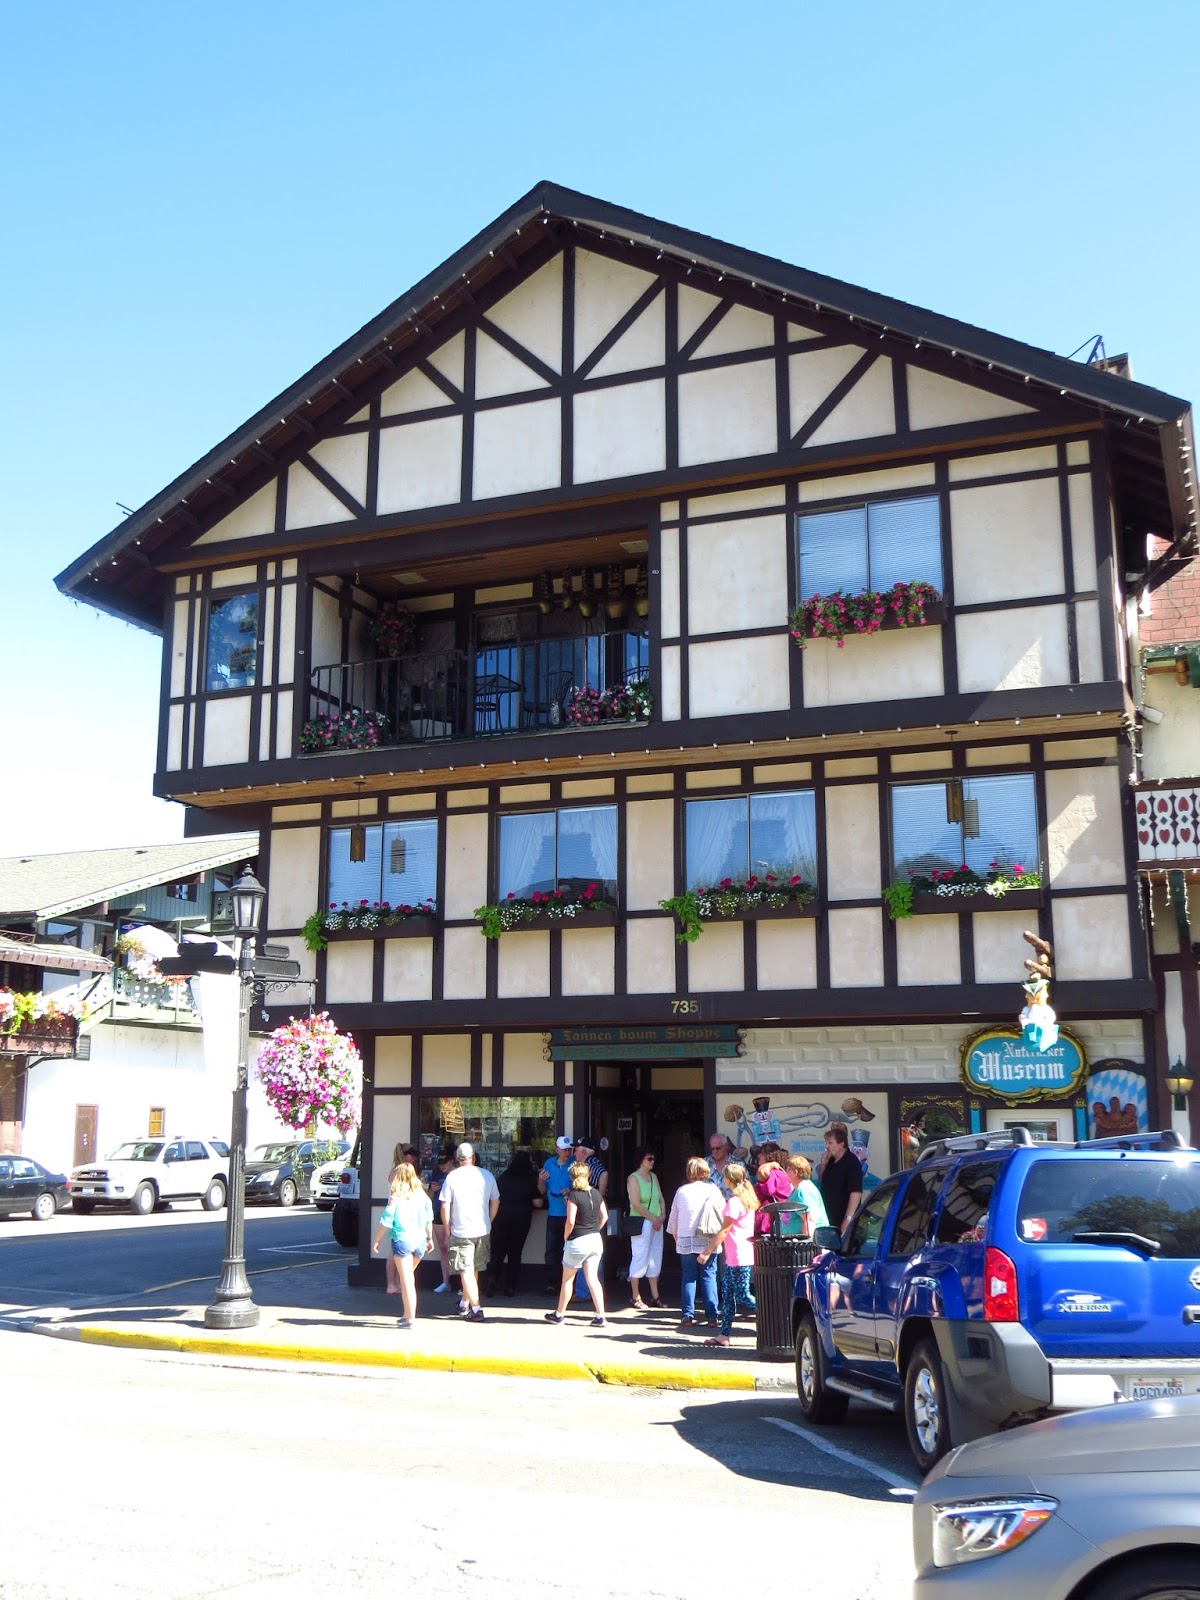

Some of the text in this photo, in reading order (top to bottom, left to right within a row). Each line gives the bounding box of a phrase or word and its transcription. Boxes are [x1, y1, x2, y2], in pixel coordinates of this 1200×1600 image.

[671, 1000, 699, 1014] 735
[665, 1026, 722, 1040] Shoppe
[972, 1050, 1065, 1081] Museum
[1058, 1303, 1112, 1313] XTERRA
